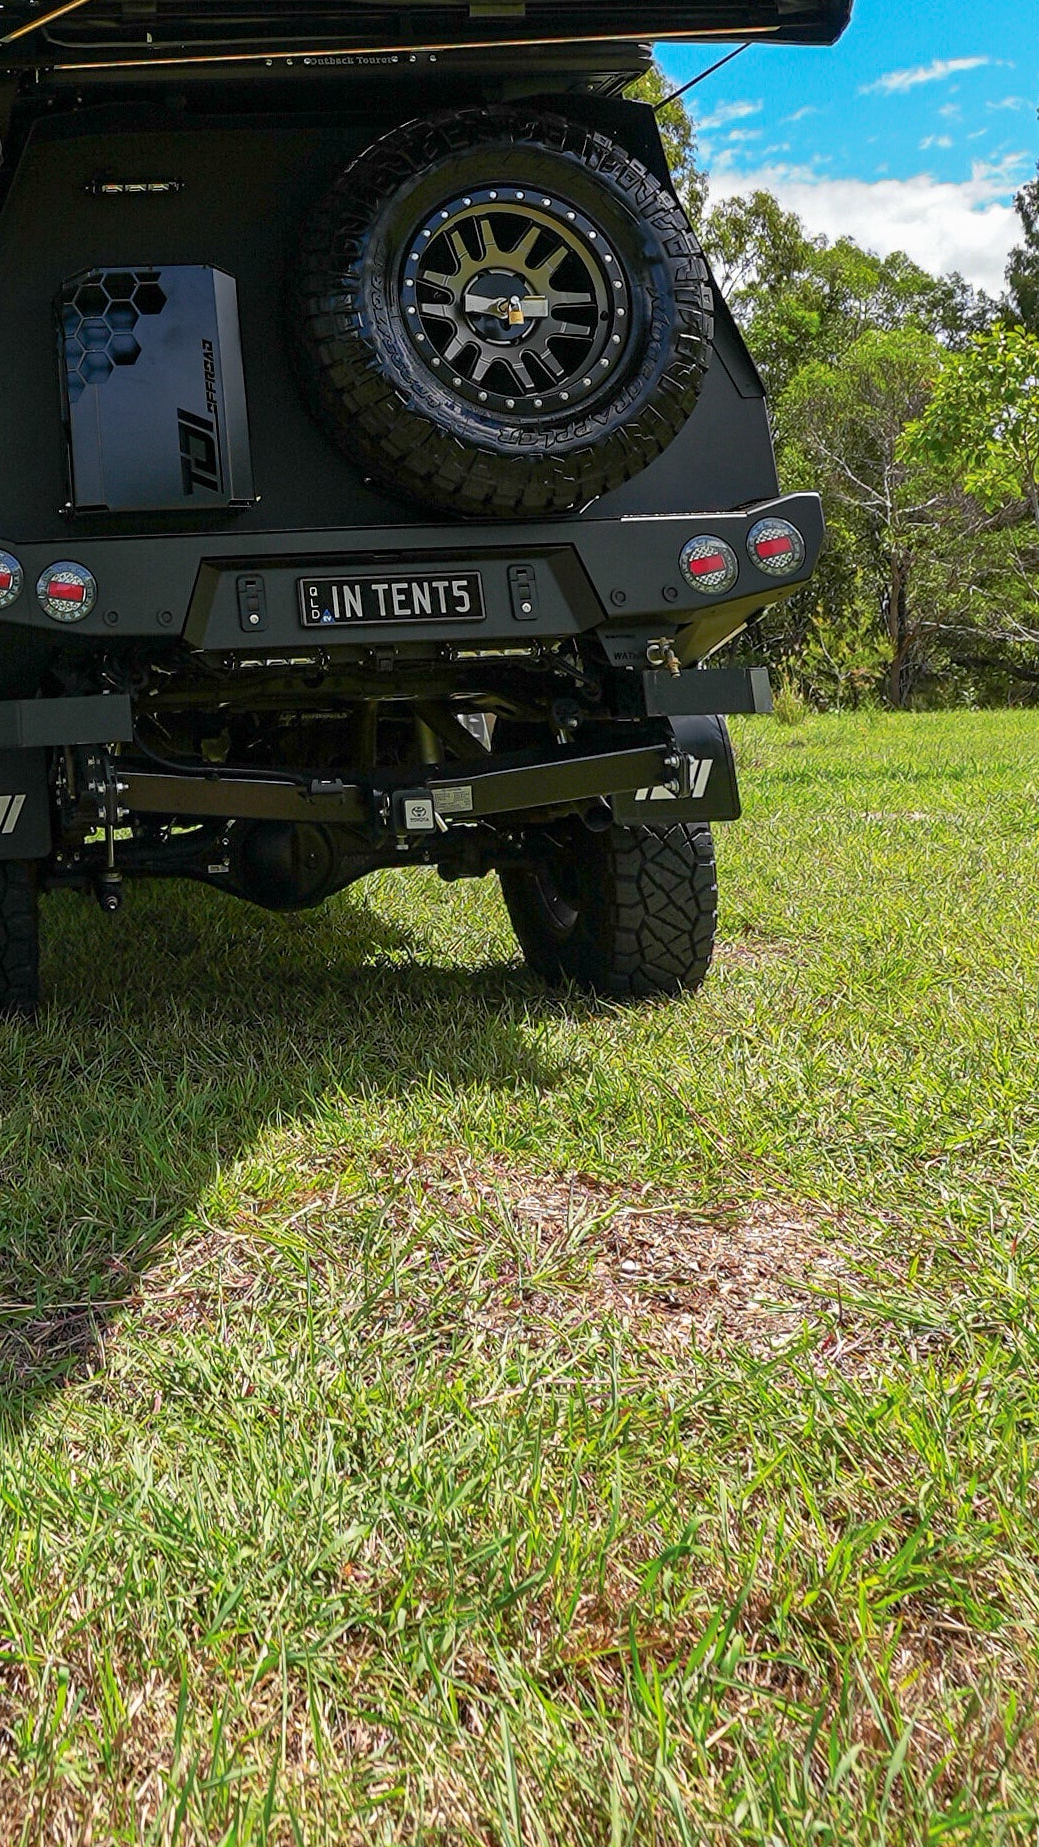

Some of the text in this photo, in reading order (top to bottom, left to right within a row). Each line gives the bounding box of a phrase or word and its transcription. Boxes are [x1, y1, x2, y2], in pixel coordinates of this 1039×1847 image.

[177, 407, 219, 496] TDI
[332, 580, 471, 618] IN TENT5
